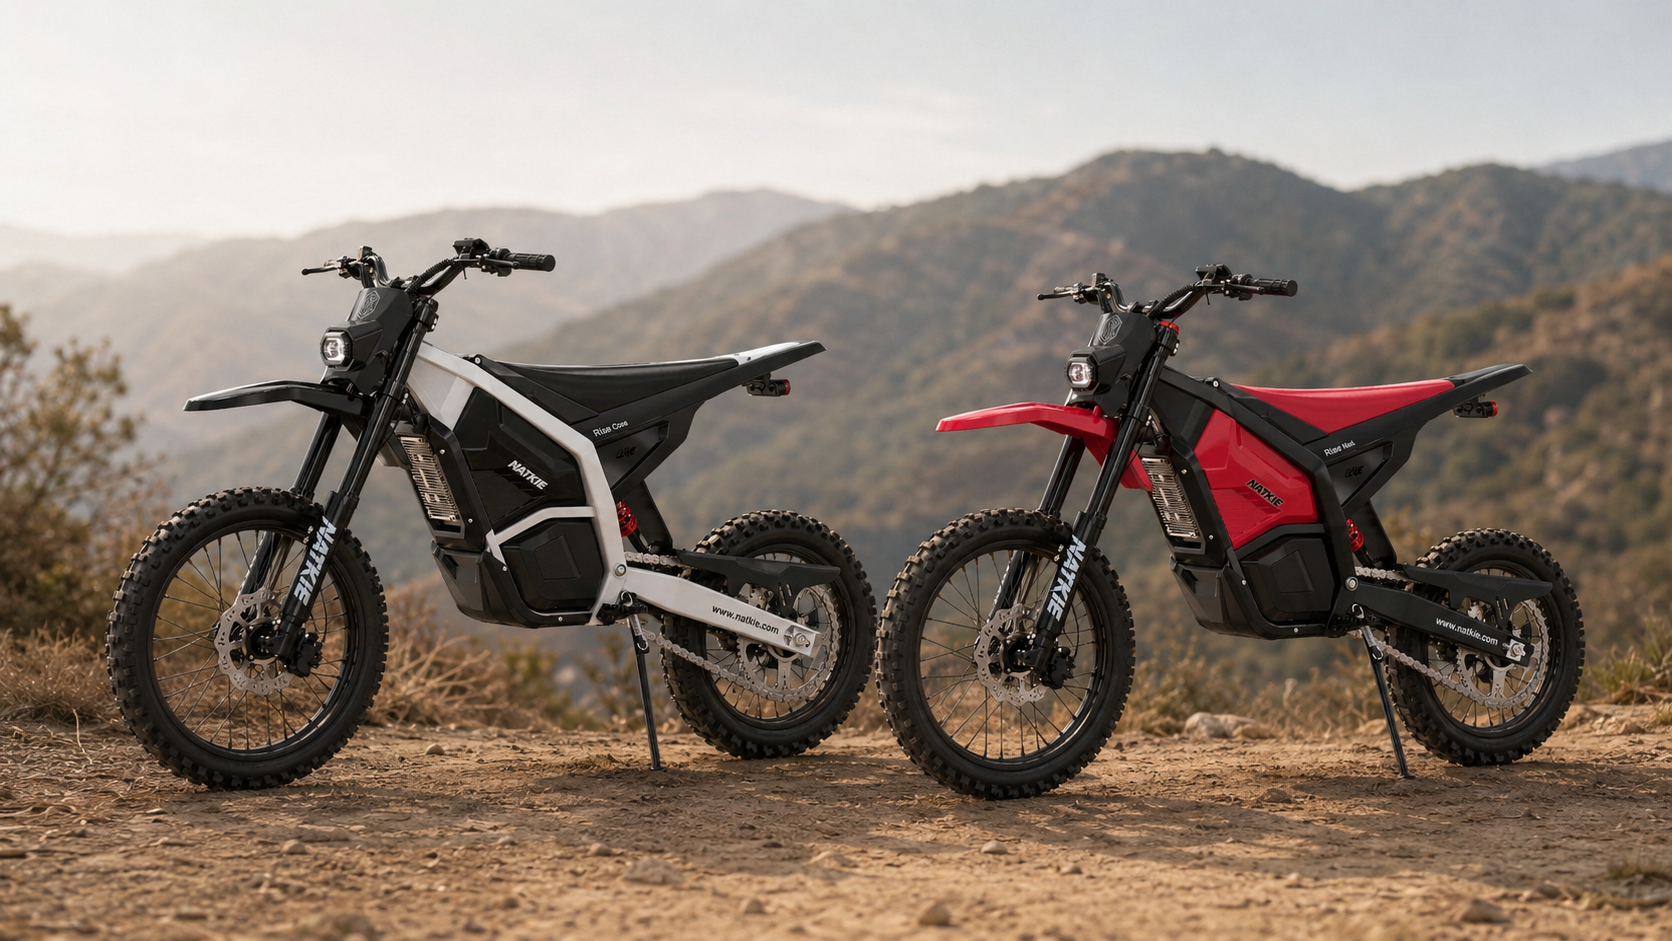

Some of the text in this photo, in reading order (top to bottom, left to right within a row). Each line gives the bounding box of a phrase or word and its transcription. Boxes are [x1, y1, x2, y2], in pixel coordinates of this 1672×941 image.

[507, 459, 548, 490] NATKIE
[1245, 478, 1284, 507] NATKIE
[293, 515, 337, 606] NATKIE
[1046, 534, 1087, 622] NATKIE
[712, 605, 779, 635] www.natkie.com
[1436, 617, 1498, 646] www.natkie.com
